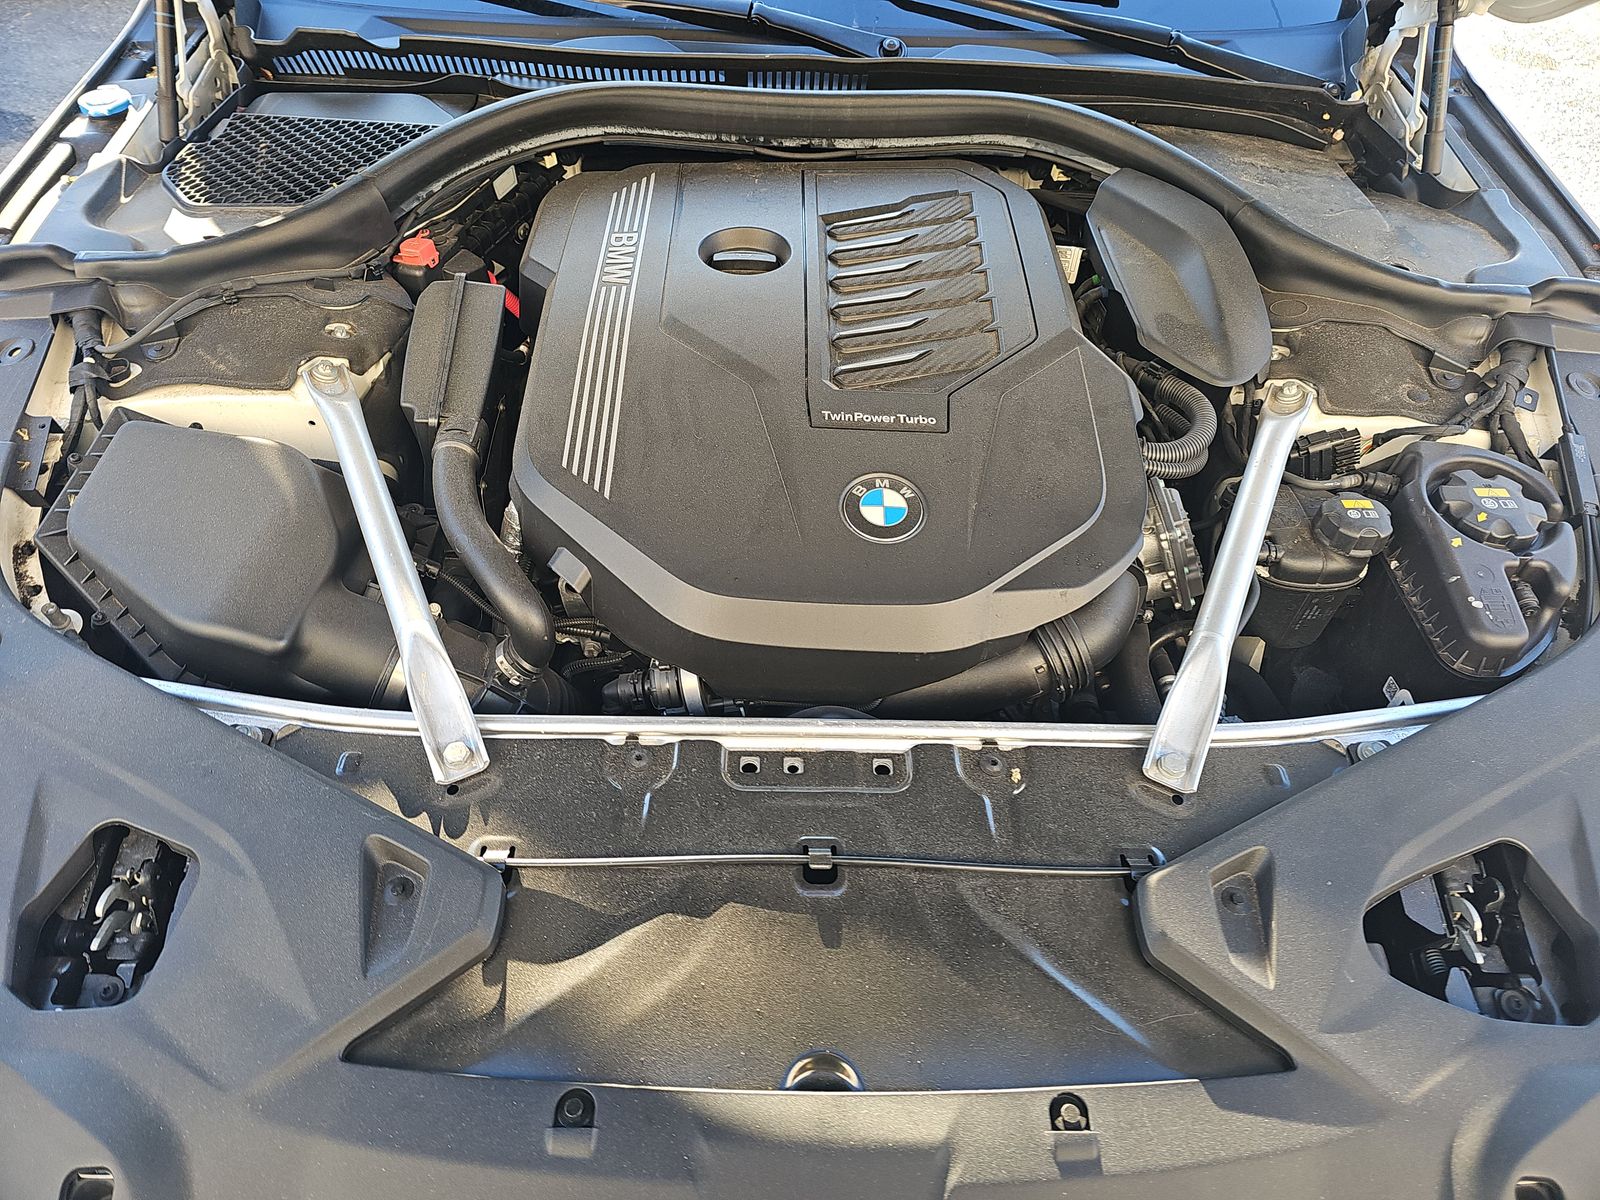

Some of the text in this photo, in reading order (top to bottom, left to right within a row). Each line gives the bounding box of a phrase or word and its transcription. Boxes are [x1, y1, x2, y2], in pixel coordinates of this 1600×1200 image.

[601, 232, 639, 285] BMW
[821, 410, 937, 425] TwinPower Turbo
[852, 478, 915, 499] BMW
